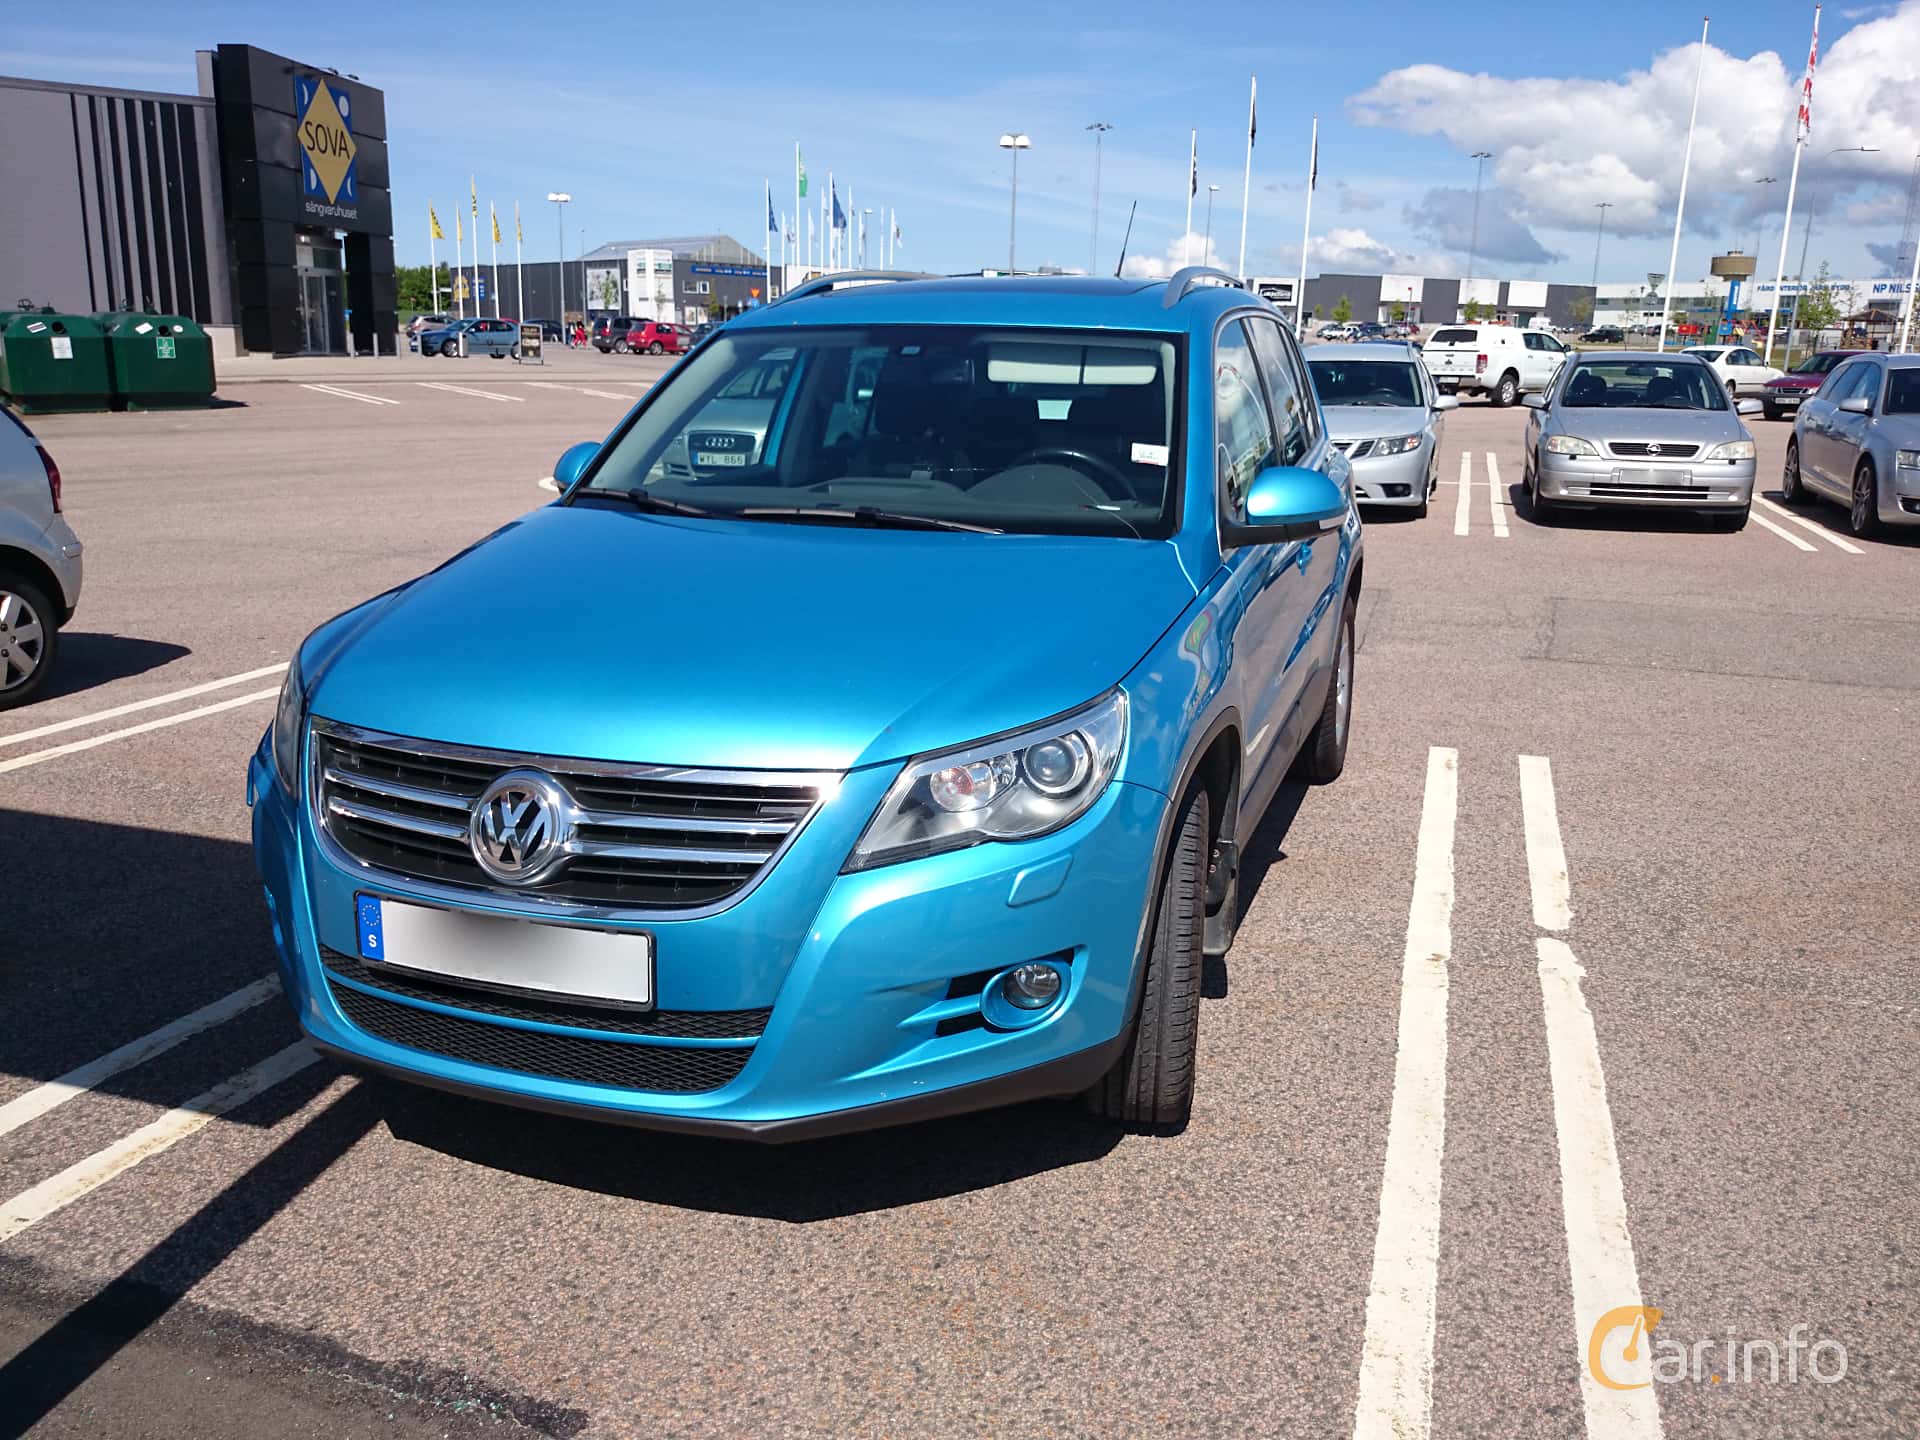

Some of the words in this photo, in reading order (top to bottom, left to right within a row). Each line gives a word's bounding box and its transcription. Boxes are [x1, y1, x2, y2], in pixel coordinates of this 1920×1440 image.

[304, 121, 350, 160] SOVA
[1872, 283, 1888, 293] NP
[368, 934, 377, 948] S
